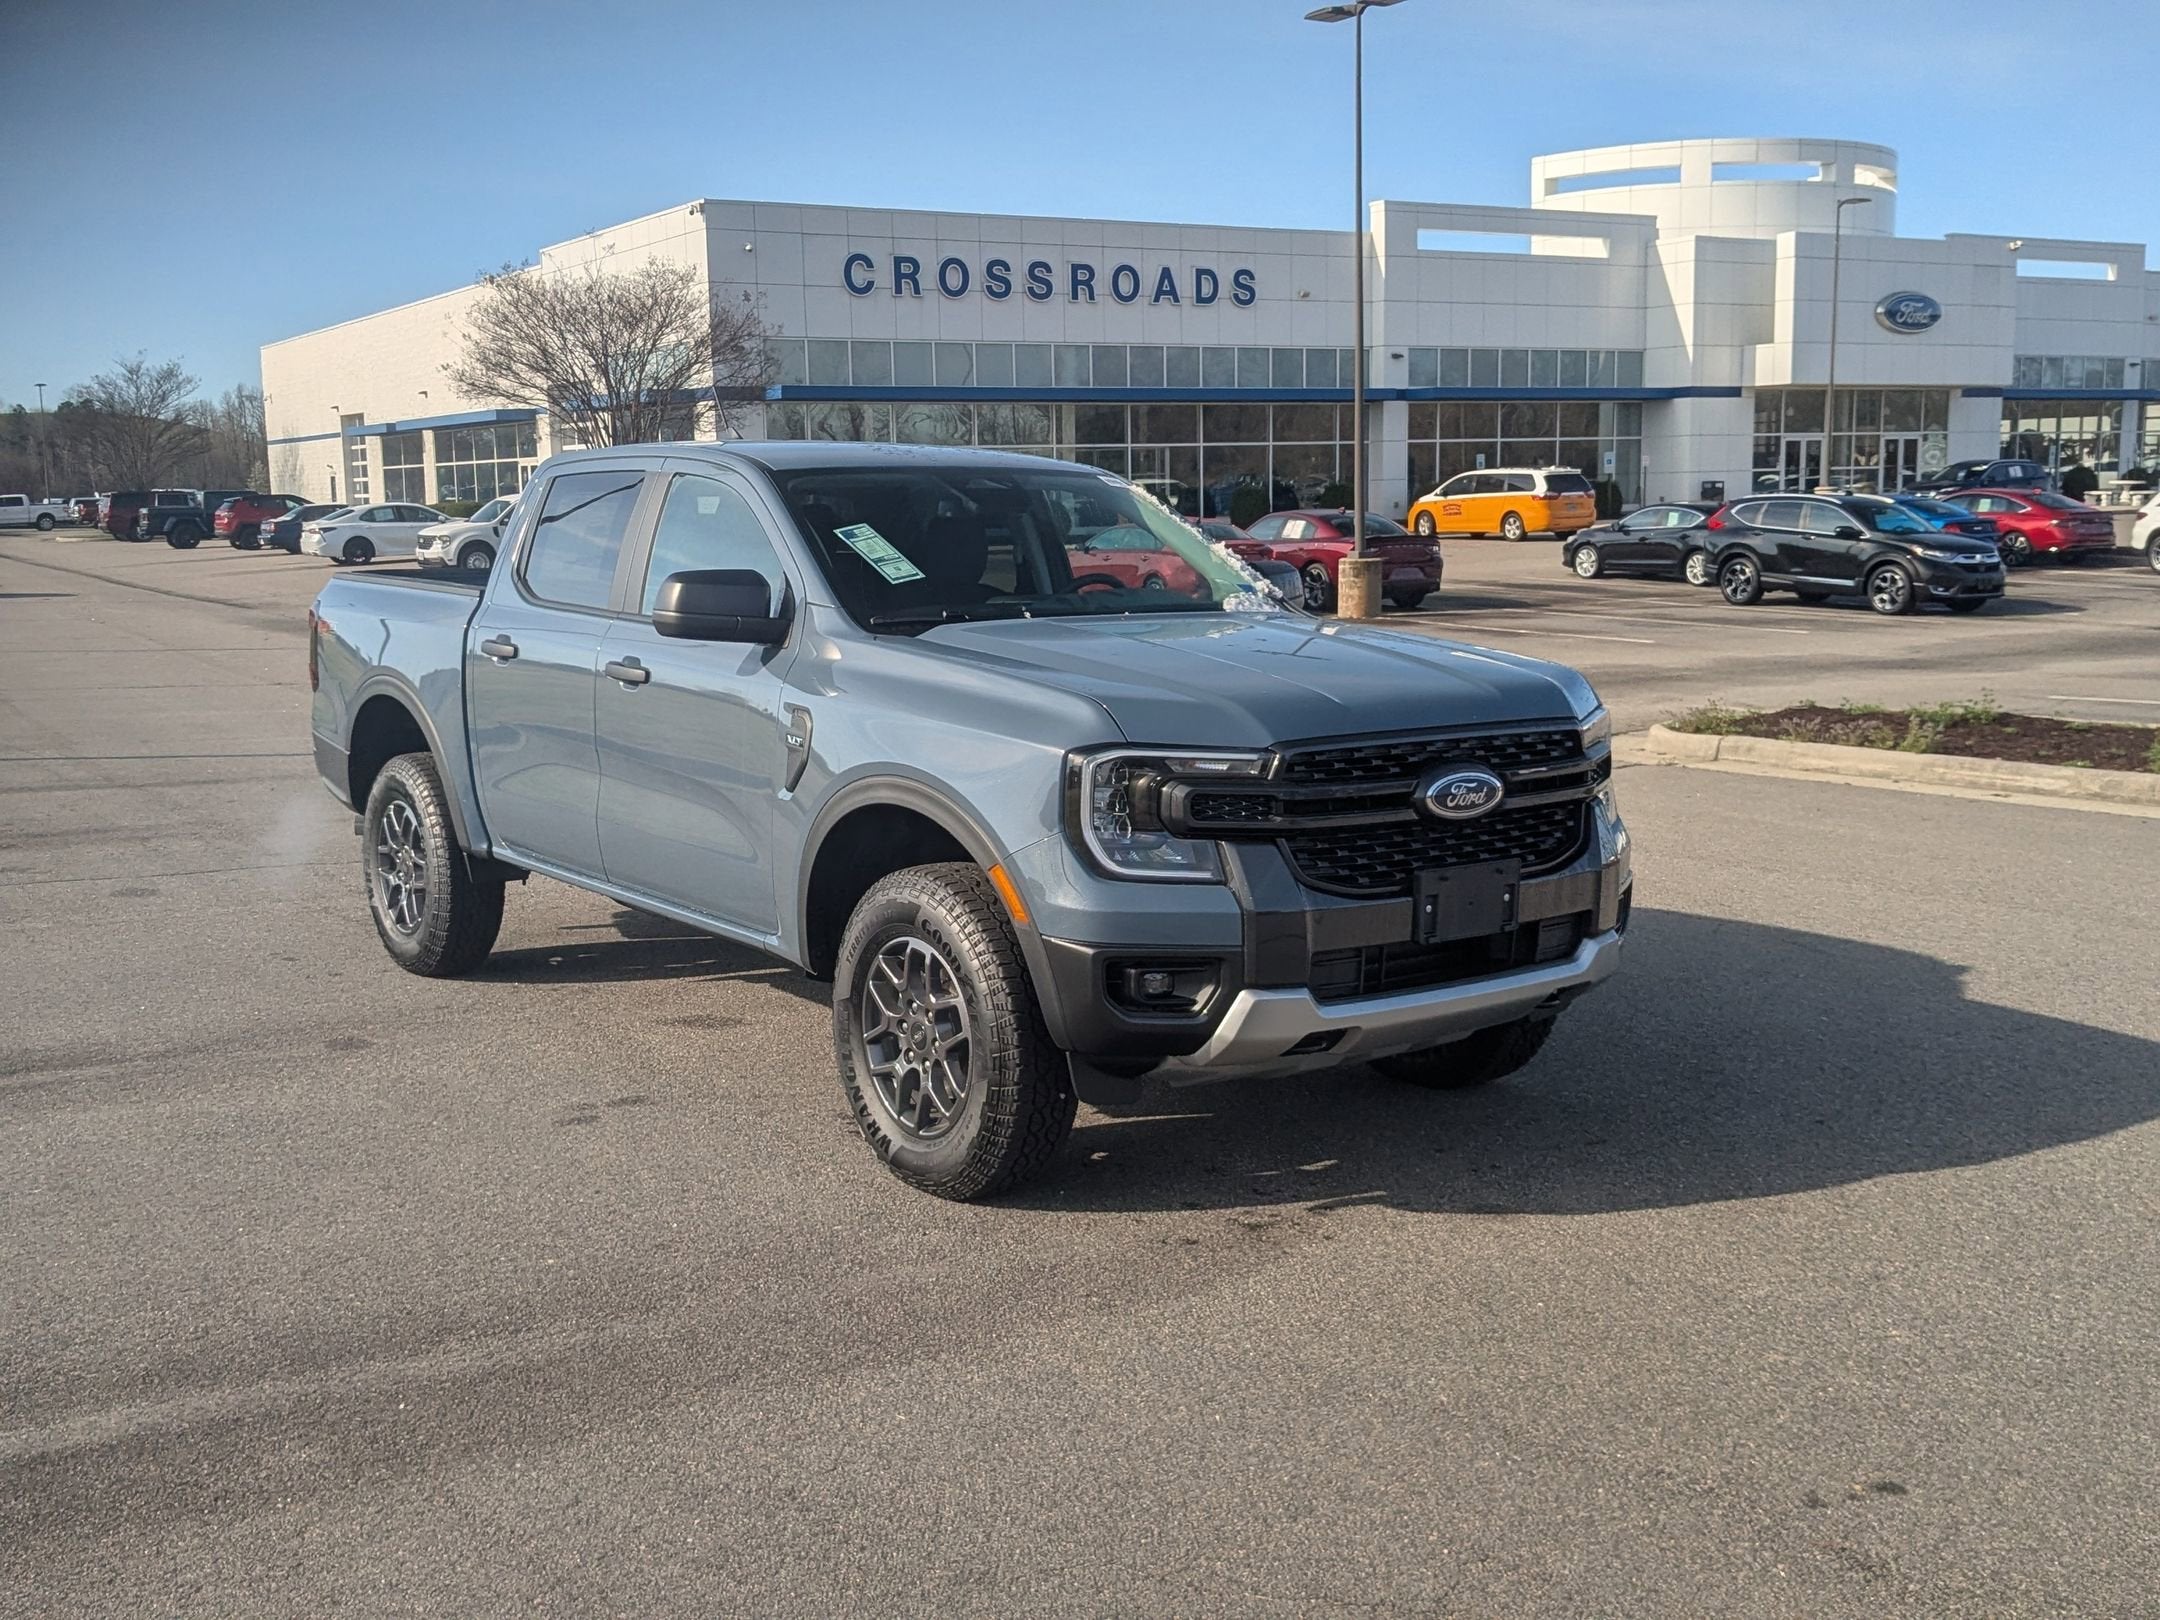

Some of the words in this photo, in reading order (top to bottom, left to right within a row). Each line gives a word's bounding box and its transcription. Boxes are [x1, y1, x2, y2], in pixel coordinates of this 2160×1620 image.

[842, 253, 1257, 307] CROSSROADS
[1896, 301, 1933, 323] Ford
[786, 734, 803, 747] XLT
[1446, 782, 1488, 807] Ford
[838, 1010, 893, 1156] WRANGL
